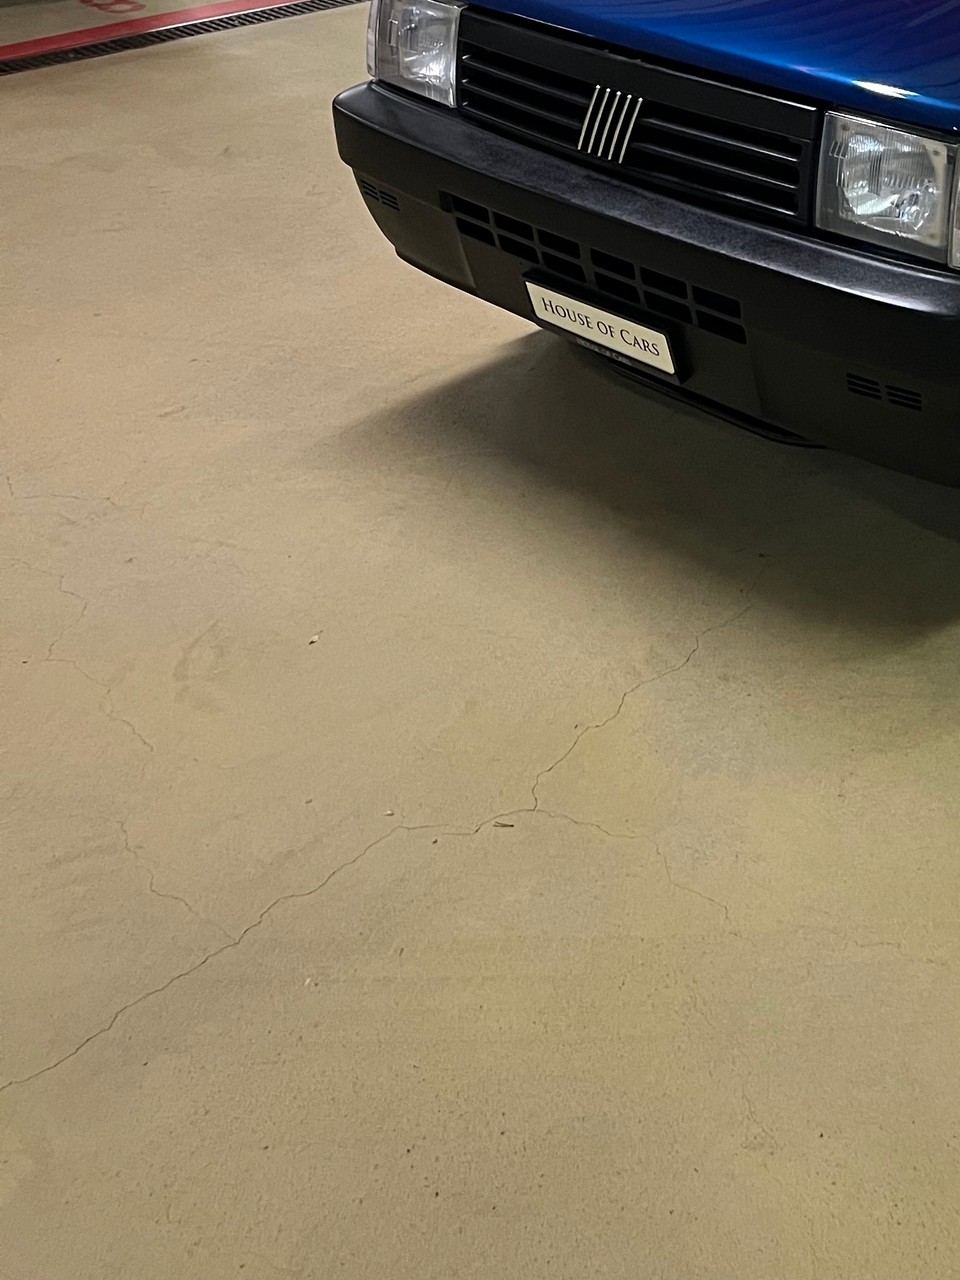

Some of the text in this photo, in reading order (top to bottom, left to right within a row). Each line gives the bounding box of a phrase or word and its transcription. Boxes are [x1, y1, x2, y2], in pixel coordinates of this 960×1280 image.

[541, 297, 594, 329] HOUSE
[596, 321, 616, 338] OF
[620, 329, 660, 356] CARS
